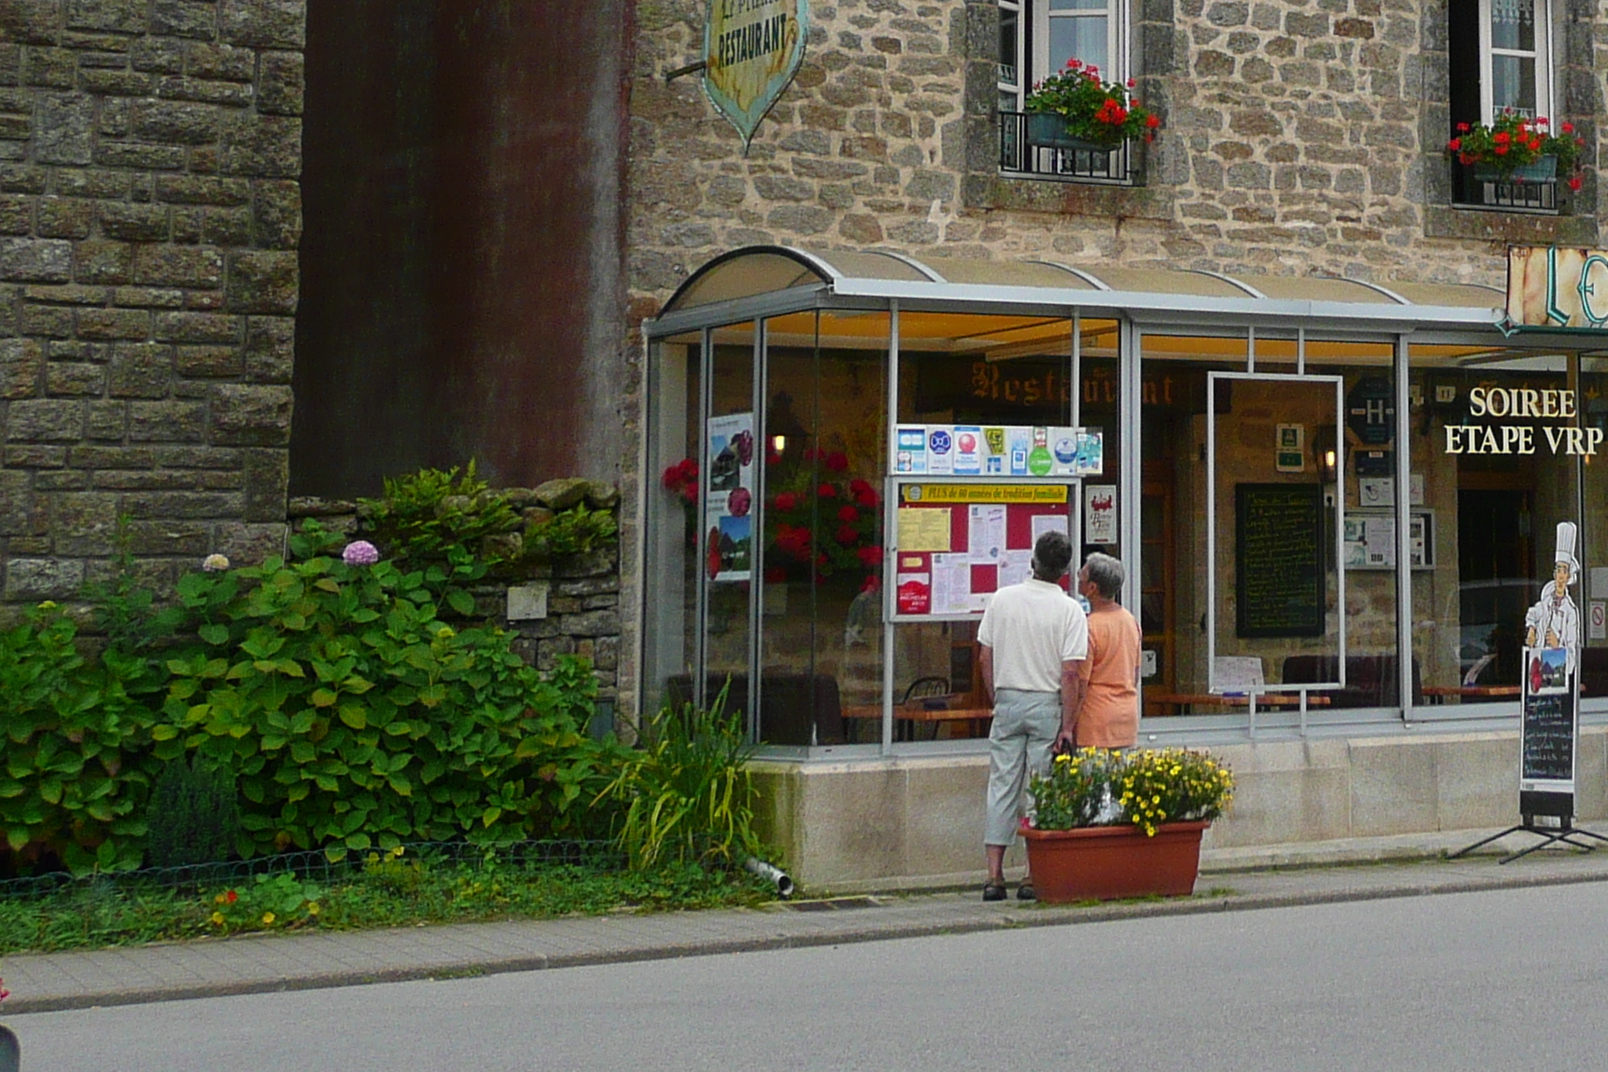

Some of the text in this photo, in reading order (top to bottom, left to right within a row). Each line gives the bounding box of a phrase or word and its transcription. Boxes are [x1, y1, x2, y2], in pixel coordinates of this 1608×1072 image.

[718, 13, 787, 69] RESTAURANT
[972, 361, 1174, 405] Restaurnt
[1469, 386, 1577, 418] SOIREE
[1443, 424, 1604, 455] ETAPE VRP
